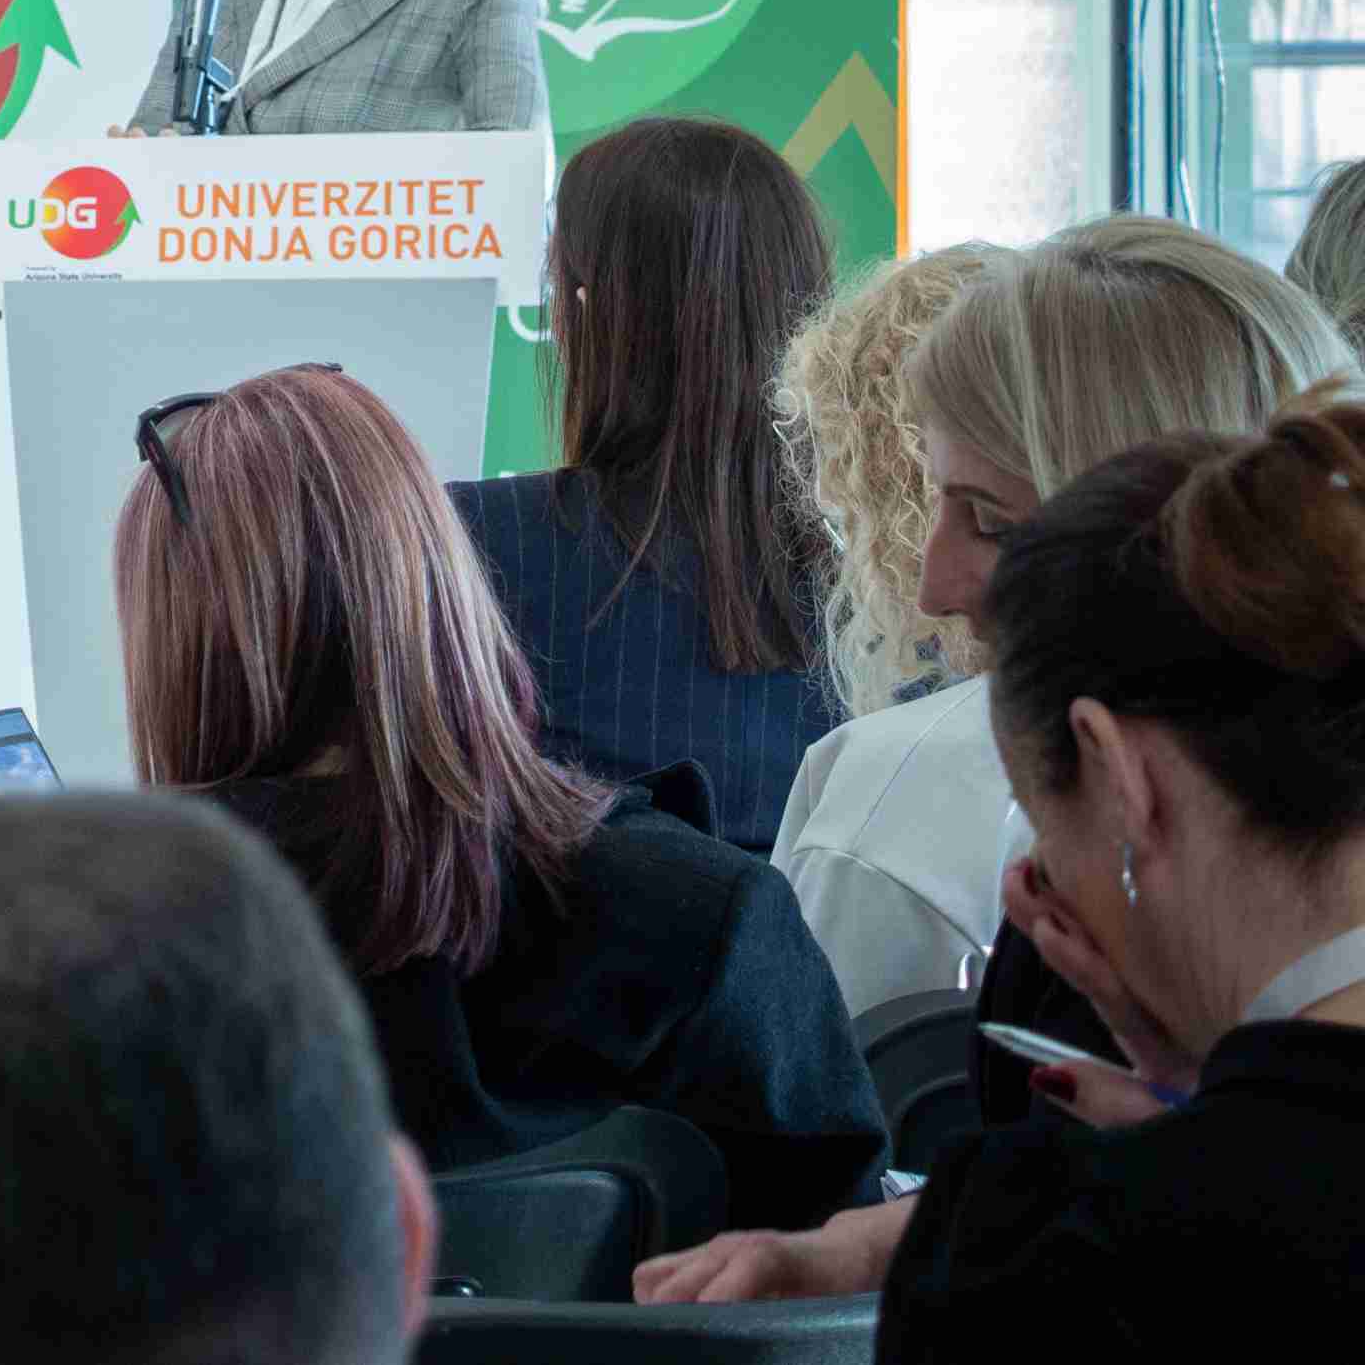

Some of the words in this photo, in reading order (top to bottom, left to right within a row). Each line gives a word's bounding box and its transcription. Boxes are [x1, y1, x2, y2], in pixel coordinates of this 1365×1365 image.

[7, 196, 98, 230] UDG
[177, 178, 485, 219] UNIVERZITET
[158, 225, 312, 262] DONJA
[328, 223, 504, 261] GORICA
